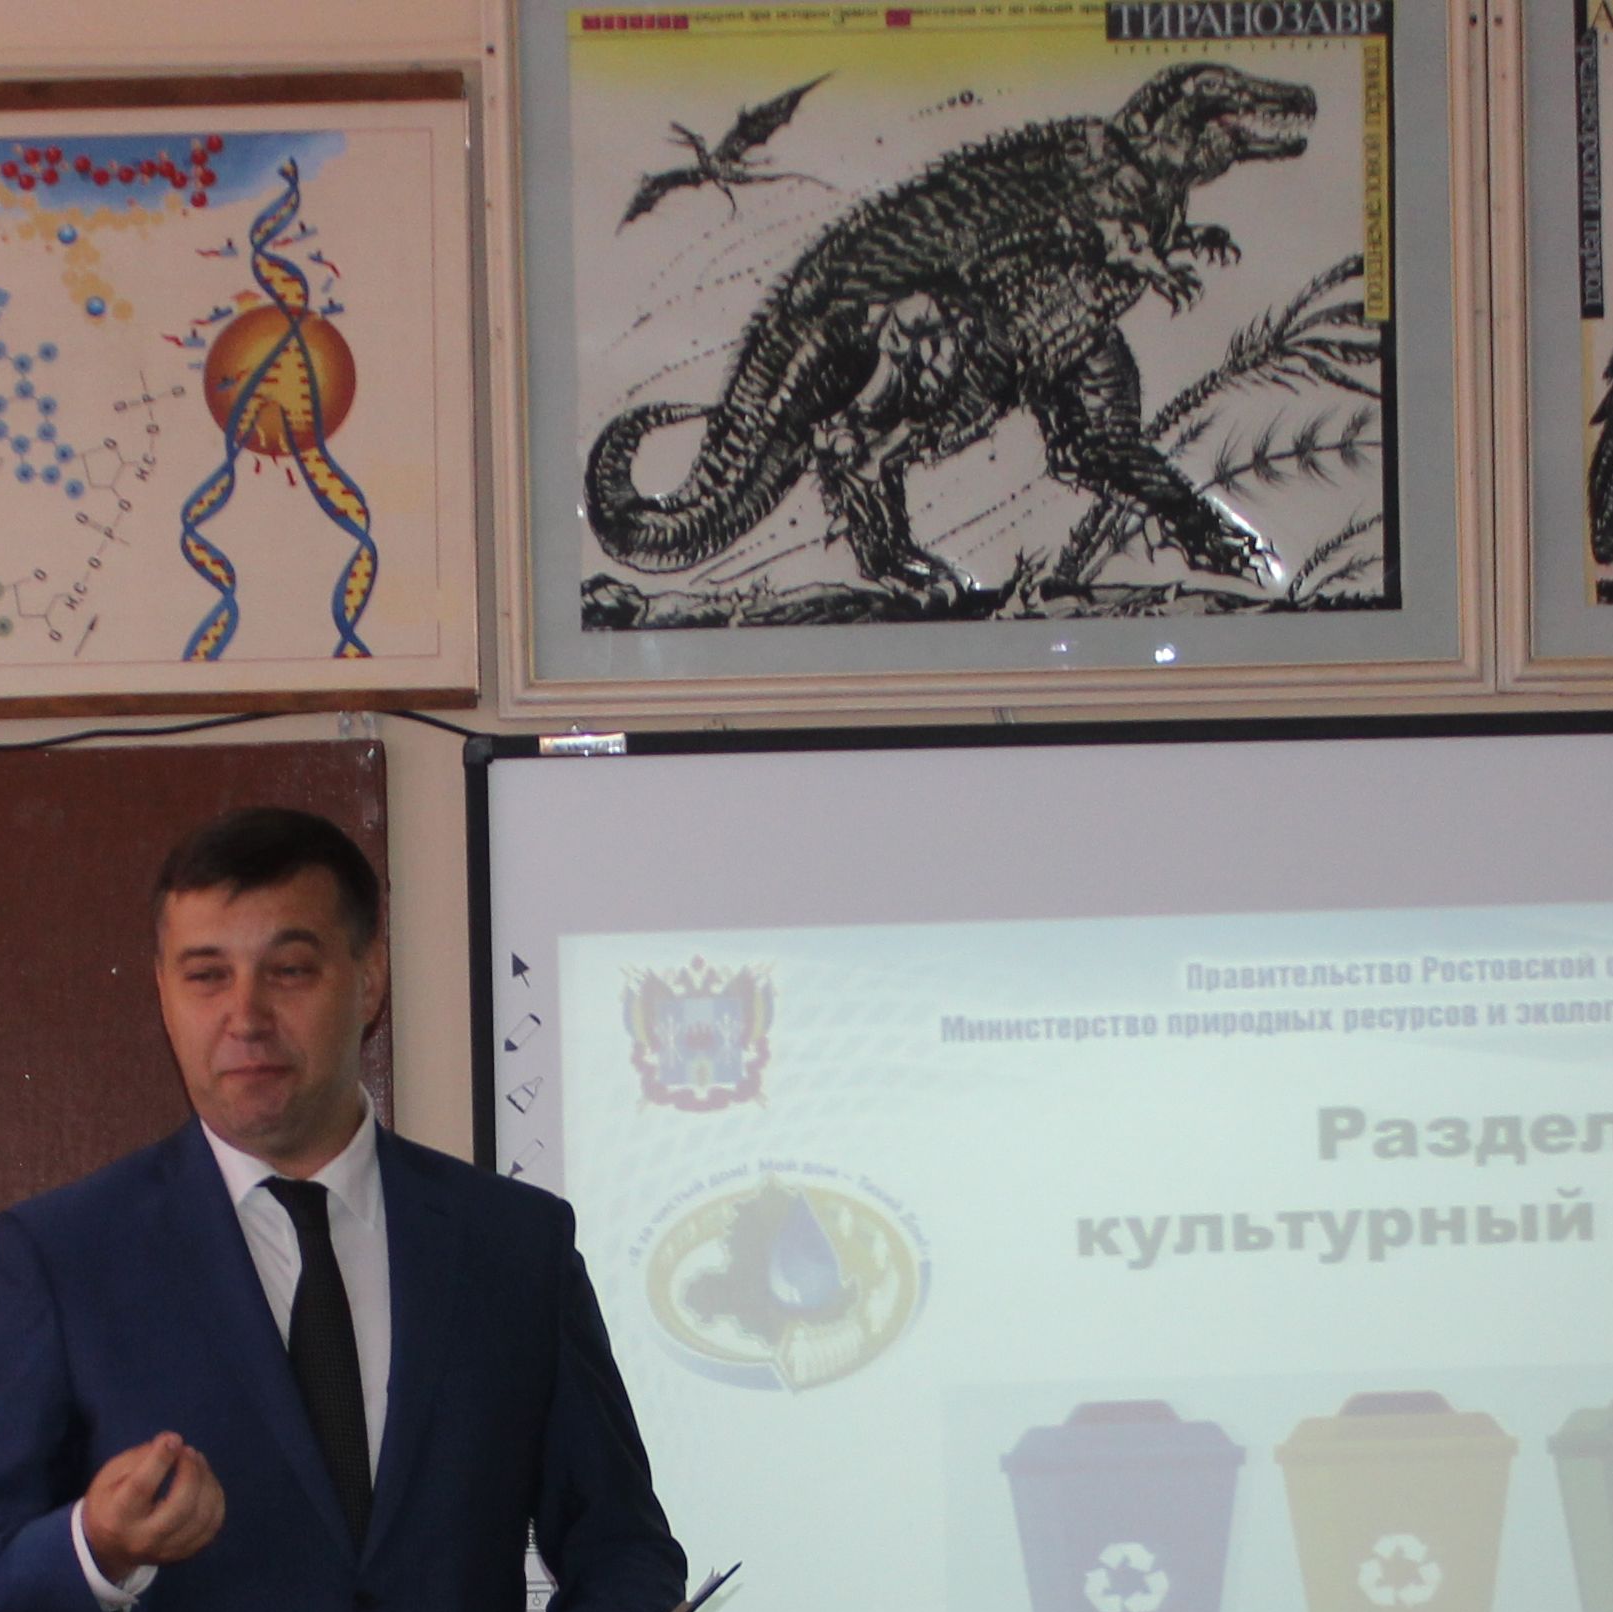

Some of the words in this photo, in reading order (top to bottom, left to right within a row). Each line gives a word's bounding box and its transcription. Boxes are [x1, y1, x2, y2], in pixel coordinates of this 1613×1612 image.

[1111, 2, 1381, 37] ТИРАНОЗАВР
[1186, 961, 1412, 992] Правительство
[1421, 952, 1595, 984] Ростовской
[941, 1011, 1158, 1042] Министерство
[1167, 1006, 1332, 1036] природных
[1343, 1003, 1478, 1032] ресурсов
[1487, 1000, 1506, 1026] и
[1076, 1188, 1595, 1268] культурный
